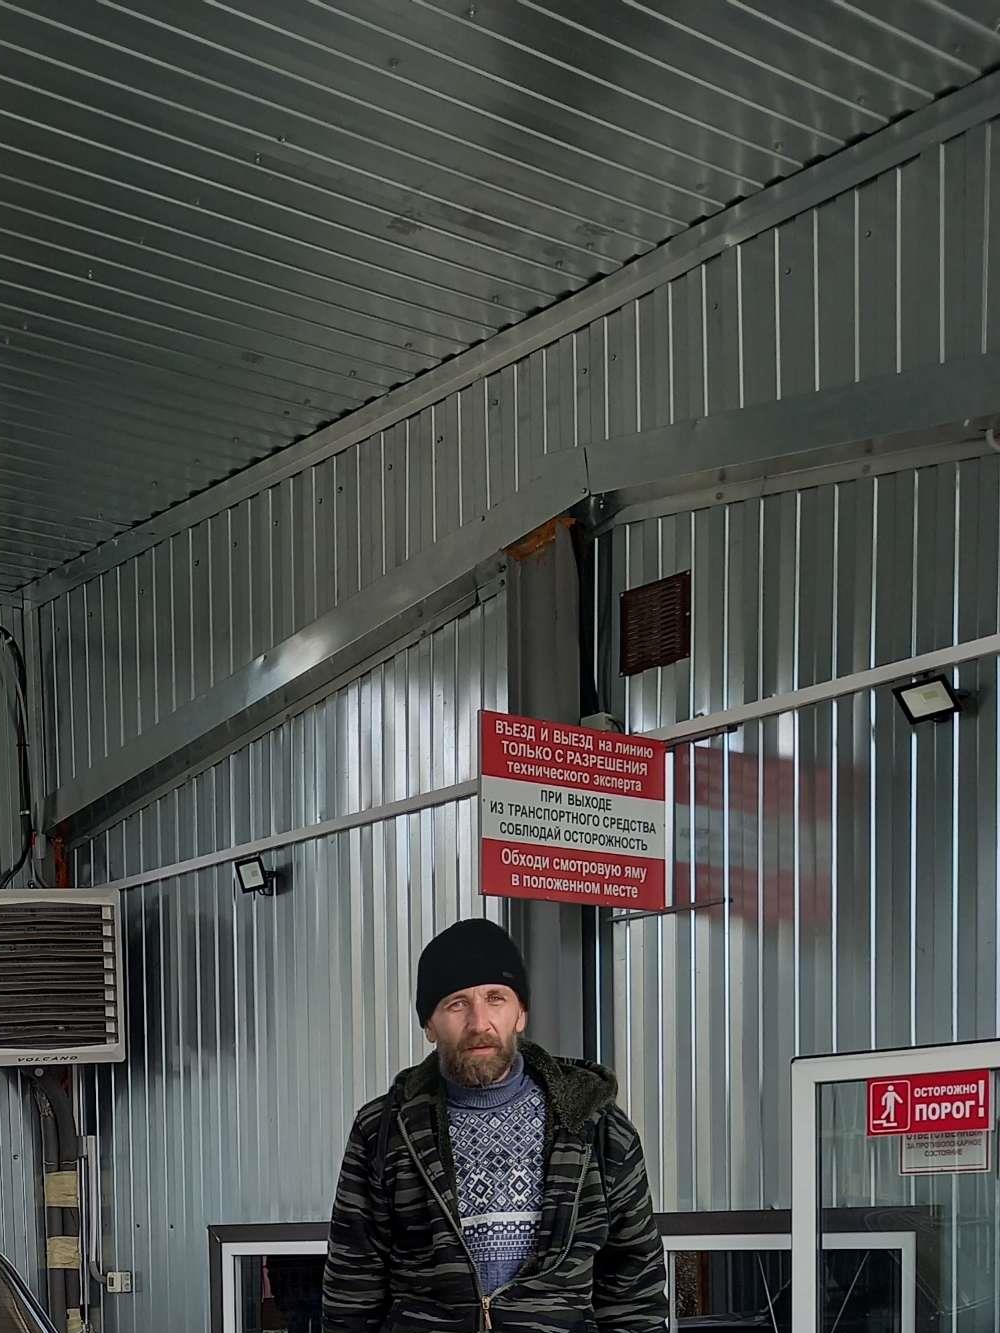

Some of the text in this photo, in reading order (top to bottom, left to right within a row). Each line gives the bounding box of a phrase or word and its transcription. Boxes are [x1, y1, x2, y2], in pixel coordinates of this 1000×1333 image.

[495, 720, 653, 759] ВЪЕЗД И ВЫЕЗД на линию
[501, 741, 648, 776] ТОЛЬКО С РАЗРЕШЕНИЯ
[507, 761, 642, 793] технического эксперта
[540, 789, 612, 812] ПРИ ВЫХОДЕ
[490, 801, 656, 834] ИЗ ТРАНСПОРТНОГО СРЕДСТВА
[500, 821, 648, 851] СОБЛЮДАЙ ОСТОРОЖНОСТЬ
[501, 848, 647, 883] Обходи смотровую яму
[511, 874, 639, 898] в положенном месте
[913, 1083, 977, 1098] ОСТОРОЖНО
